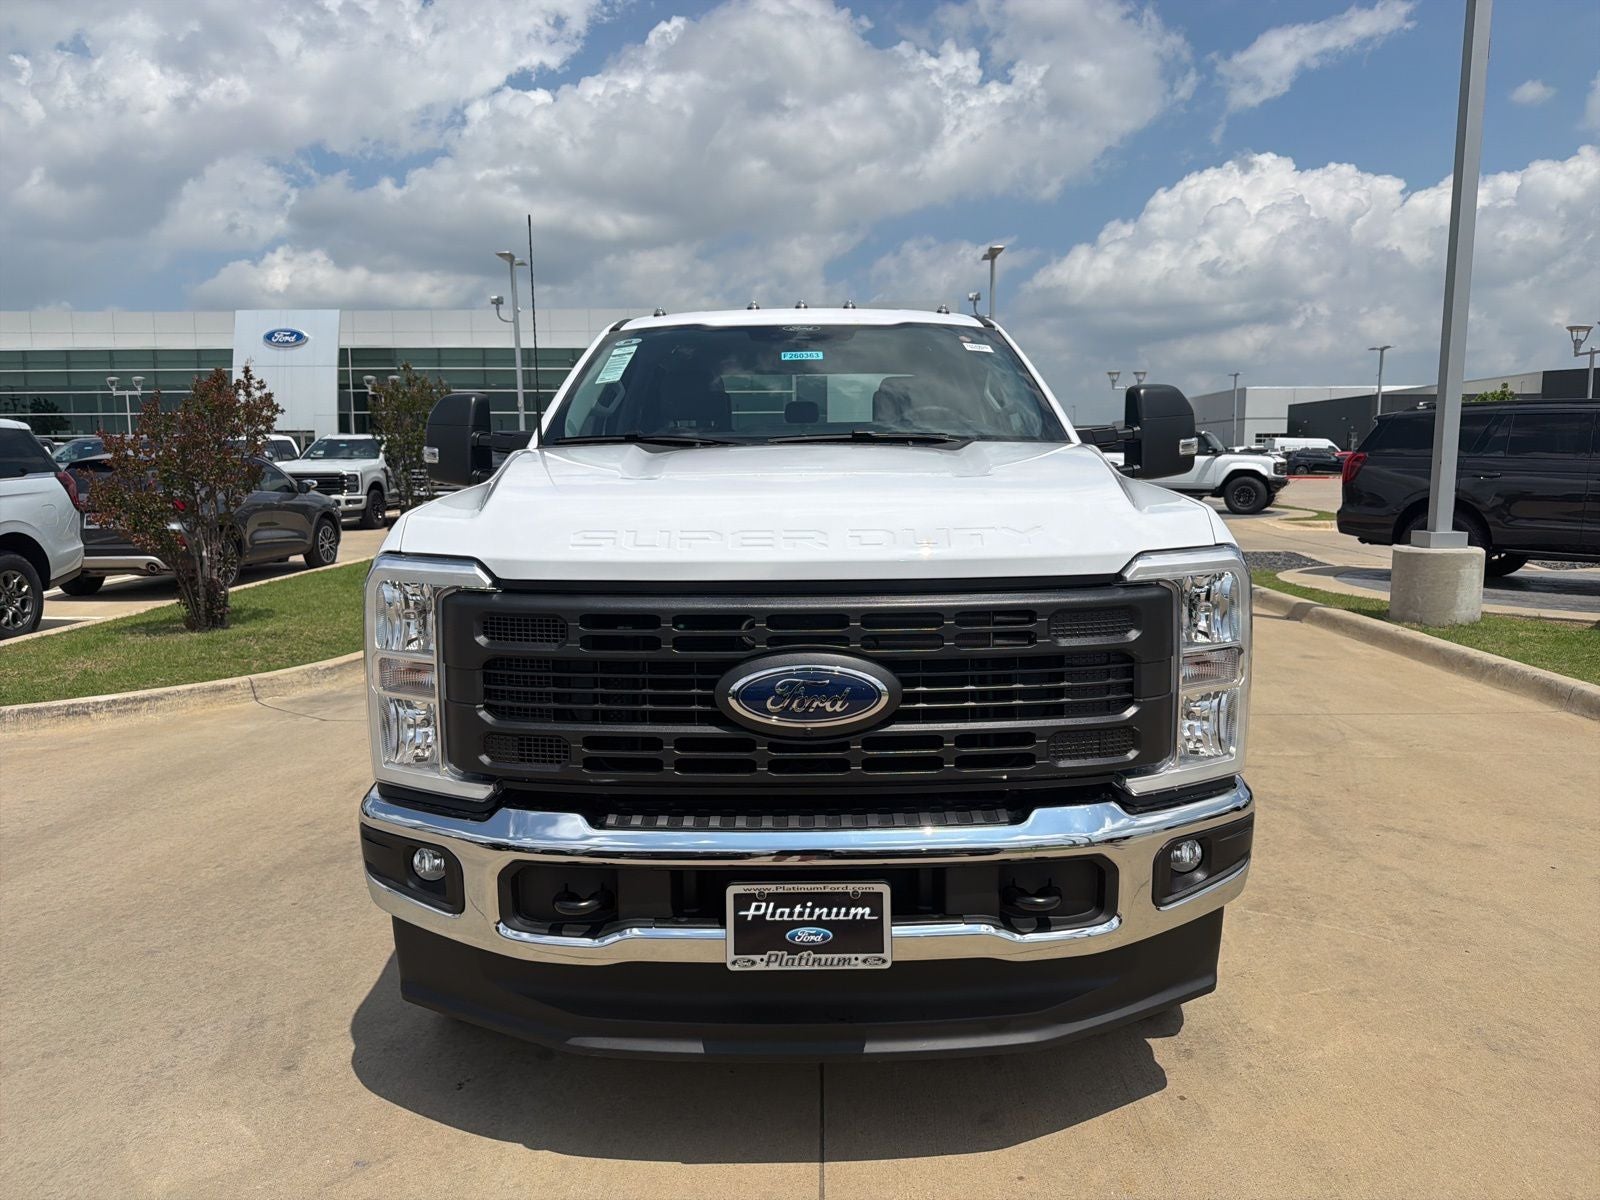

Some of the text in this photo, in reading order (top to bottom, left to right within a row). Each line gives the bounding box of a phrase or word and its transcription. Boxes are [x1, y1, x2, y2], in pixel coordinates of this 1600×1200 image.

[271, 331, 297, 343] Ford
[568, 525, 1043, 551] SUPER DUTY
[766, 678, 851, 713] Ford
[738, 901, 878, 921] Platinum
[794, 930, 824, 942] Ford
[765, 950, 859, 968] Platinum
